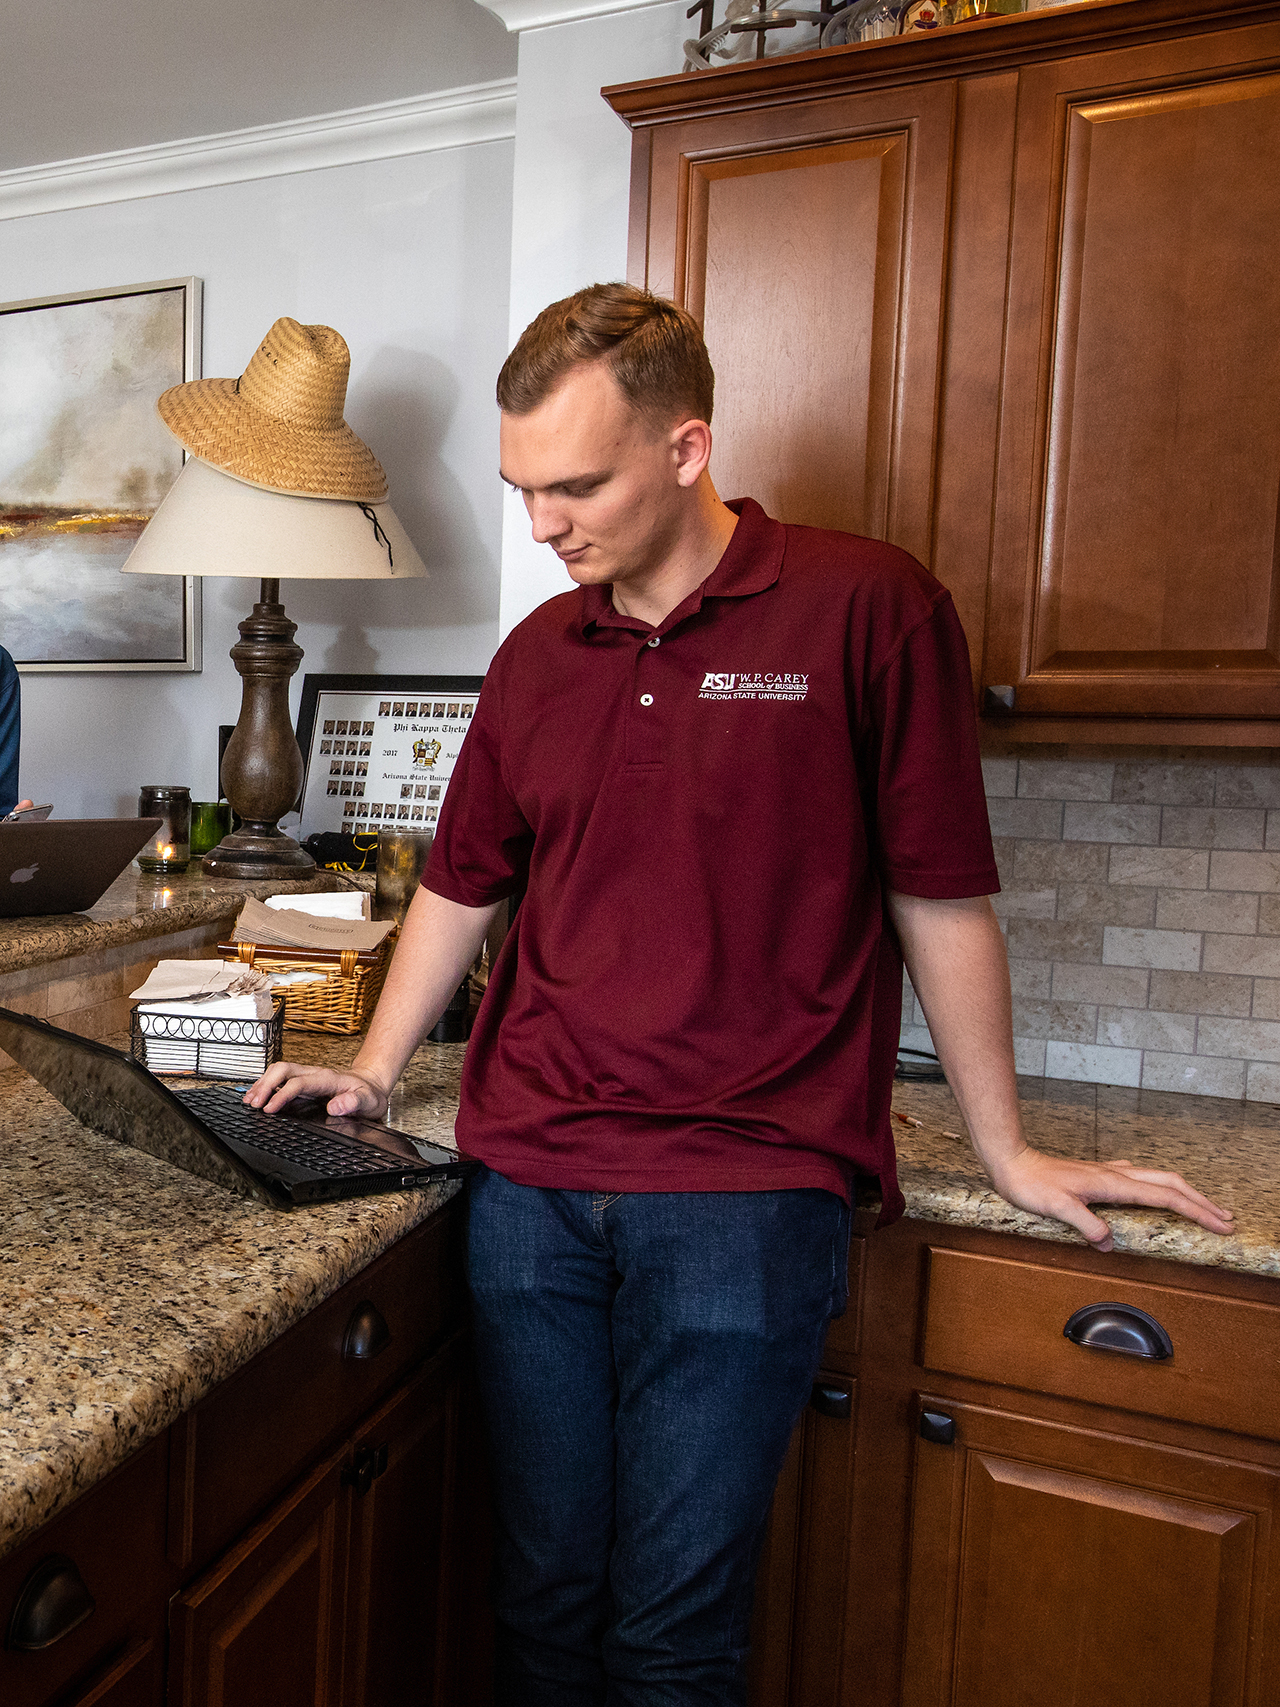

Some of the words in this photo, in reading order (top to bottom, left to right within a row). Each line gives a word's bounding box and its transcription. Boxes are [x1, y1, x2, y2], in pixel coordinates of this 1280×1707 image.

[700, 672, 736, 690] ASU
[764, 673, 809, 684] CAREY
[774, 683, 809, 691] BUSINESS
[698, 692, 732, 700] ARIZONA
[758, 692, 806, 701] UNIVERSITY
[393, 723, 408, 732] Phi
[411, 723, 439, 733] Kappa
[441, 724, 467, 734] Theta
[382, 772, 408, 780] Arizona
[409, 773, 427, 781] State
